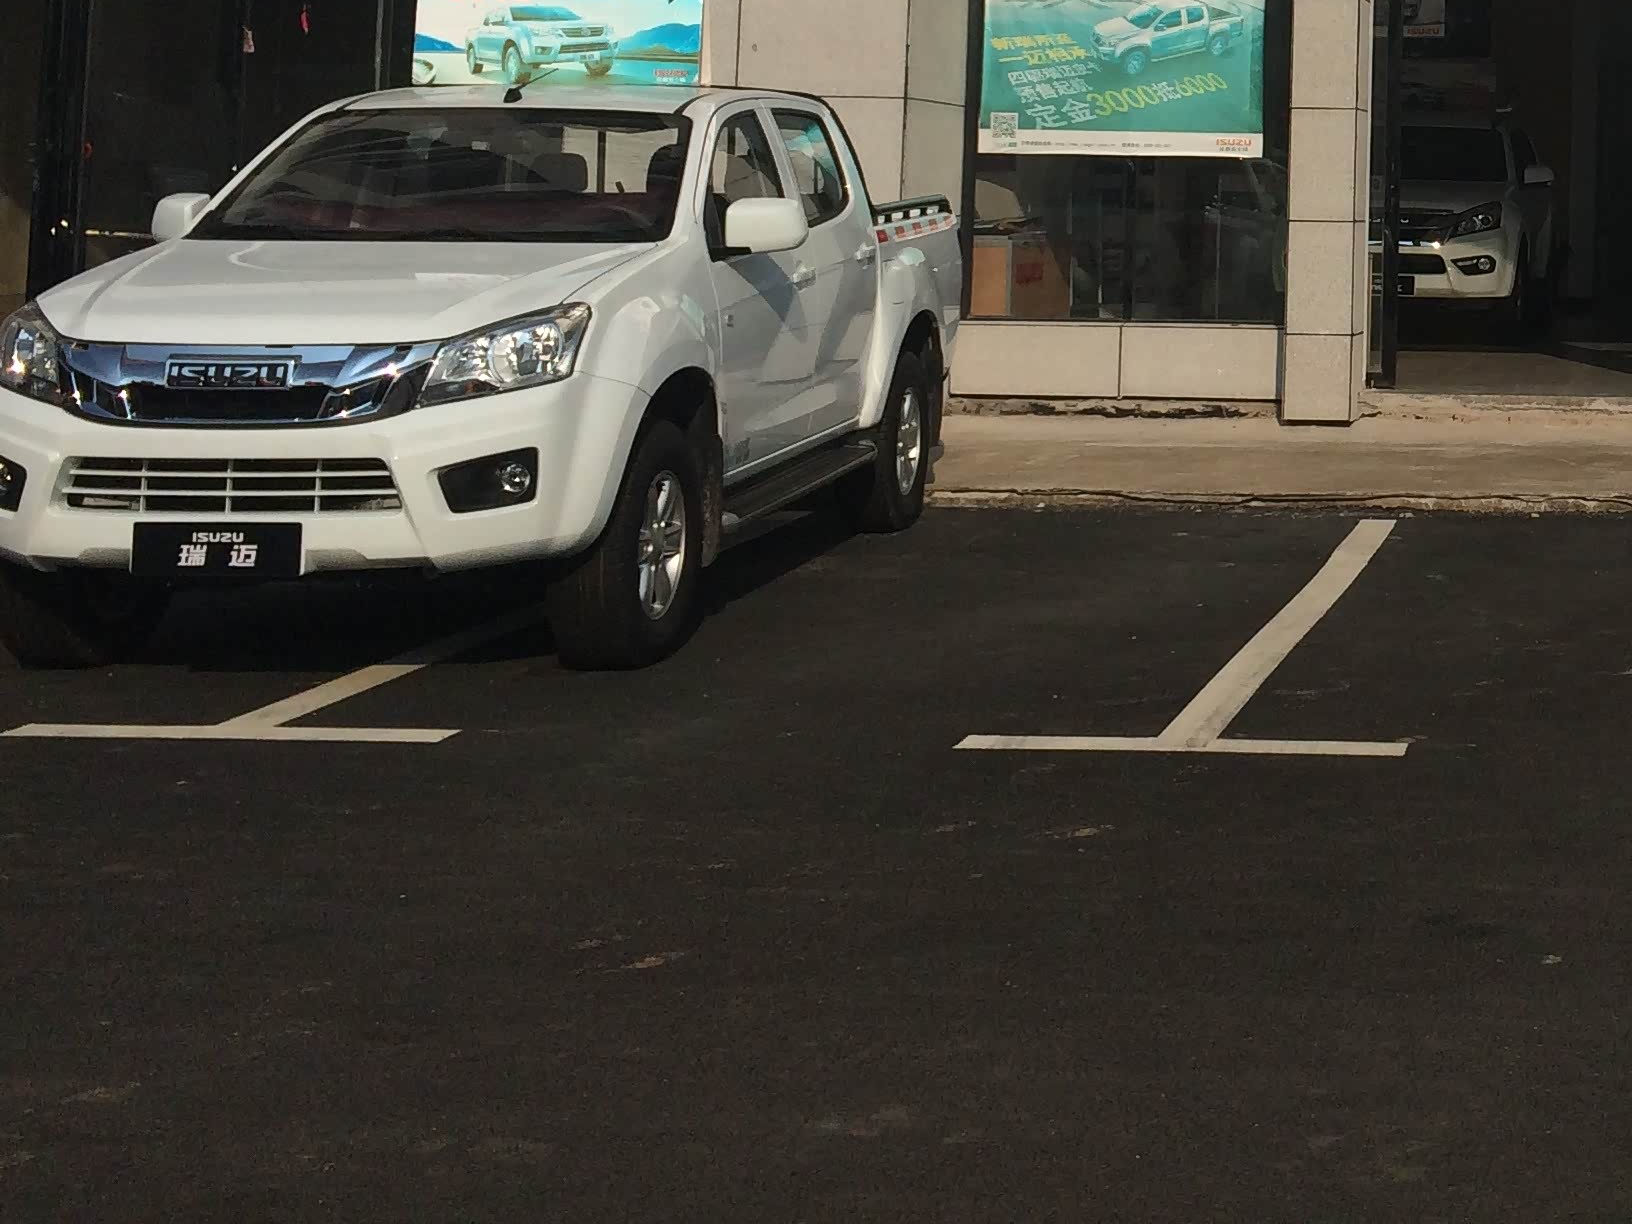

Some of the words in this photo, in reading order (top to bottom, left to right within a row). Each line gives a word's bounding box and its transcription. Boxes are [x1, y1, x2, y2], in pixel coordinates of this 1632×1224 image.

[1215, 138, 1252, 147] ISUZU
[169, 365, 287, 387] ISUZU
[191, 531, 245, 543] ISUZU
